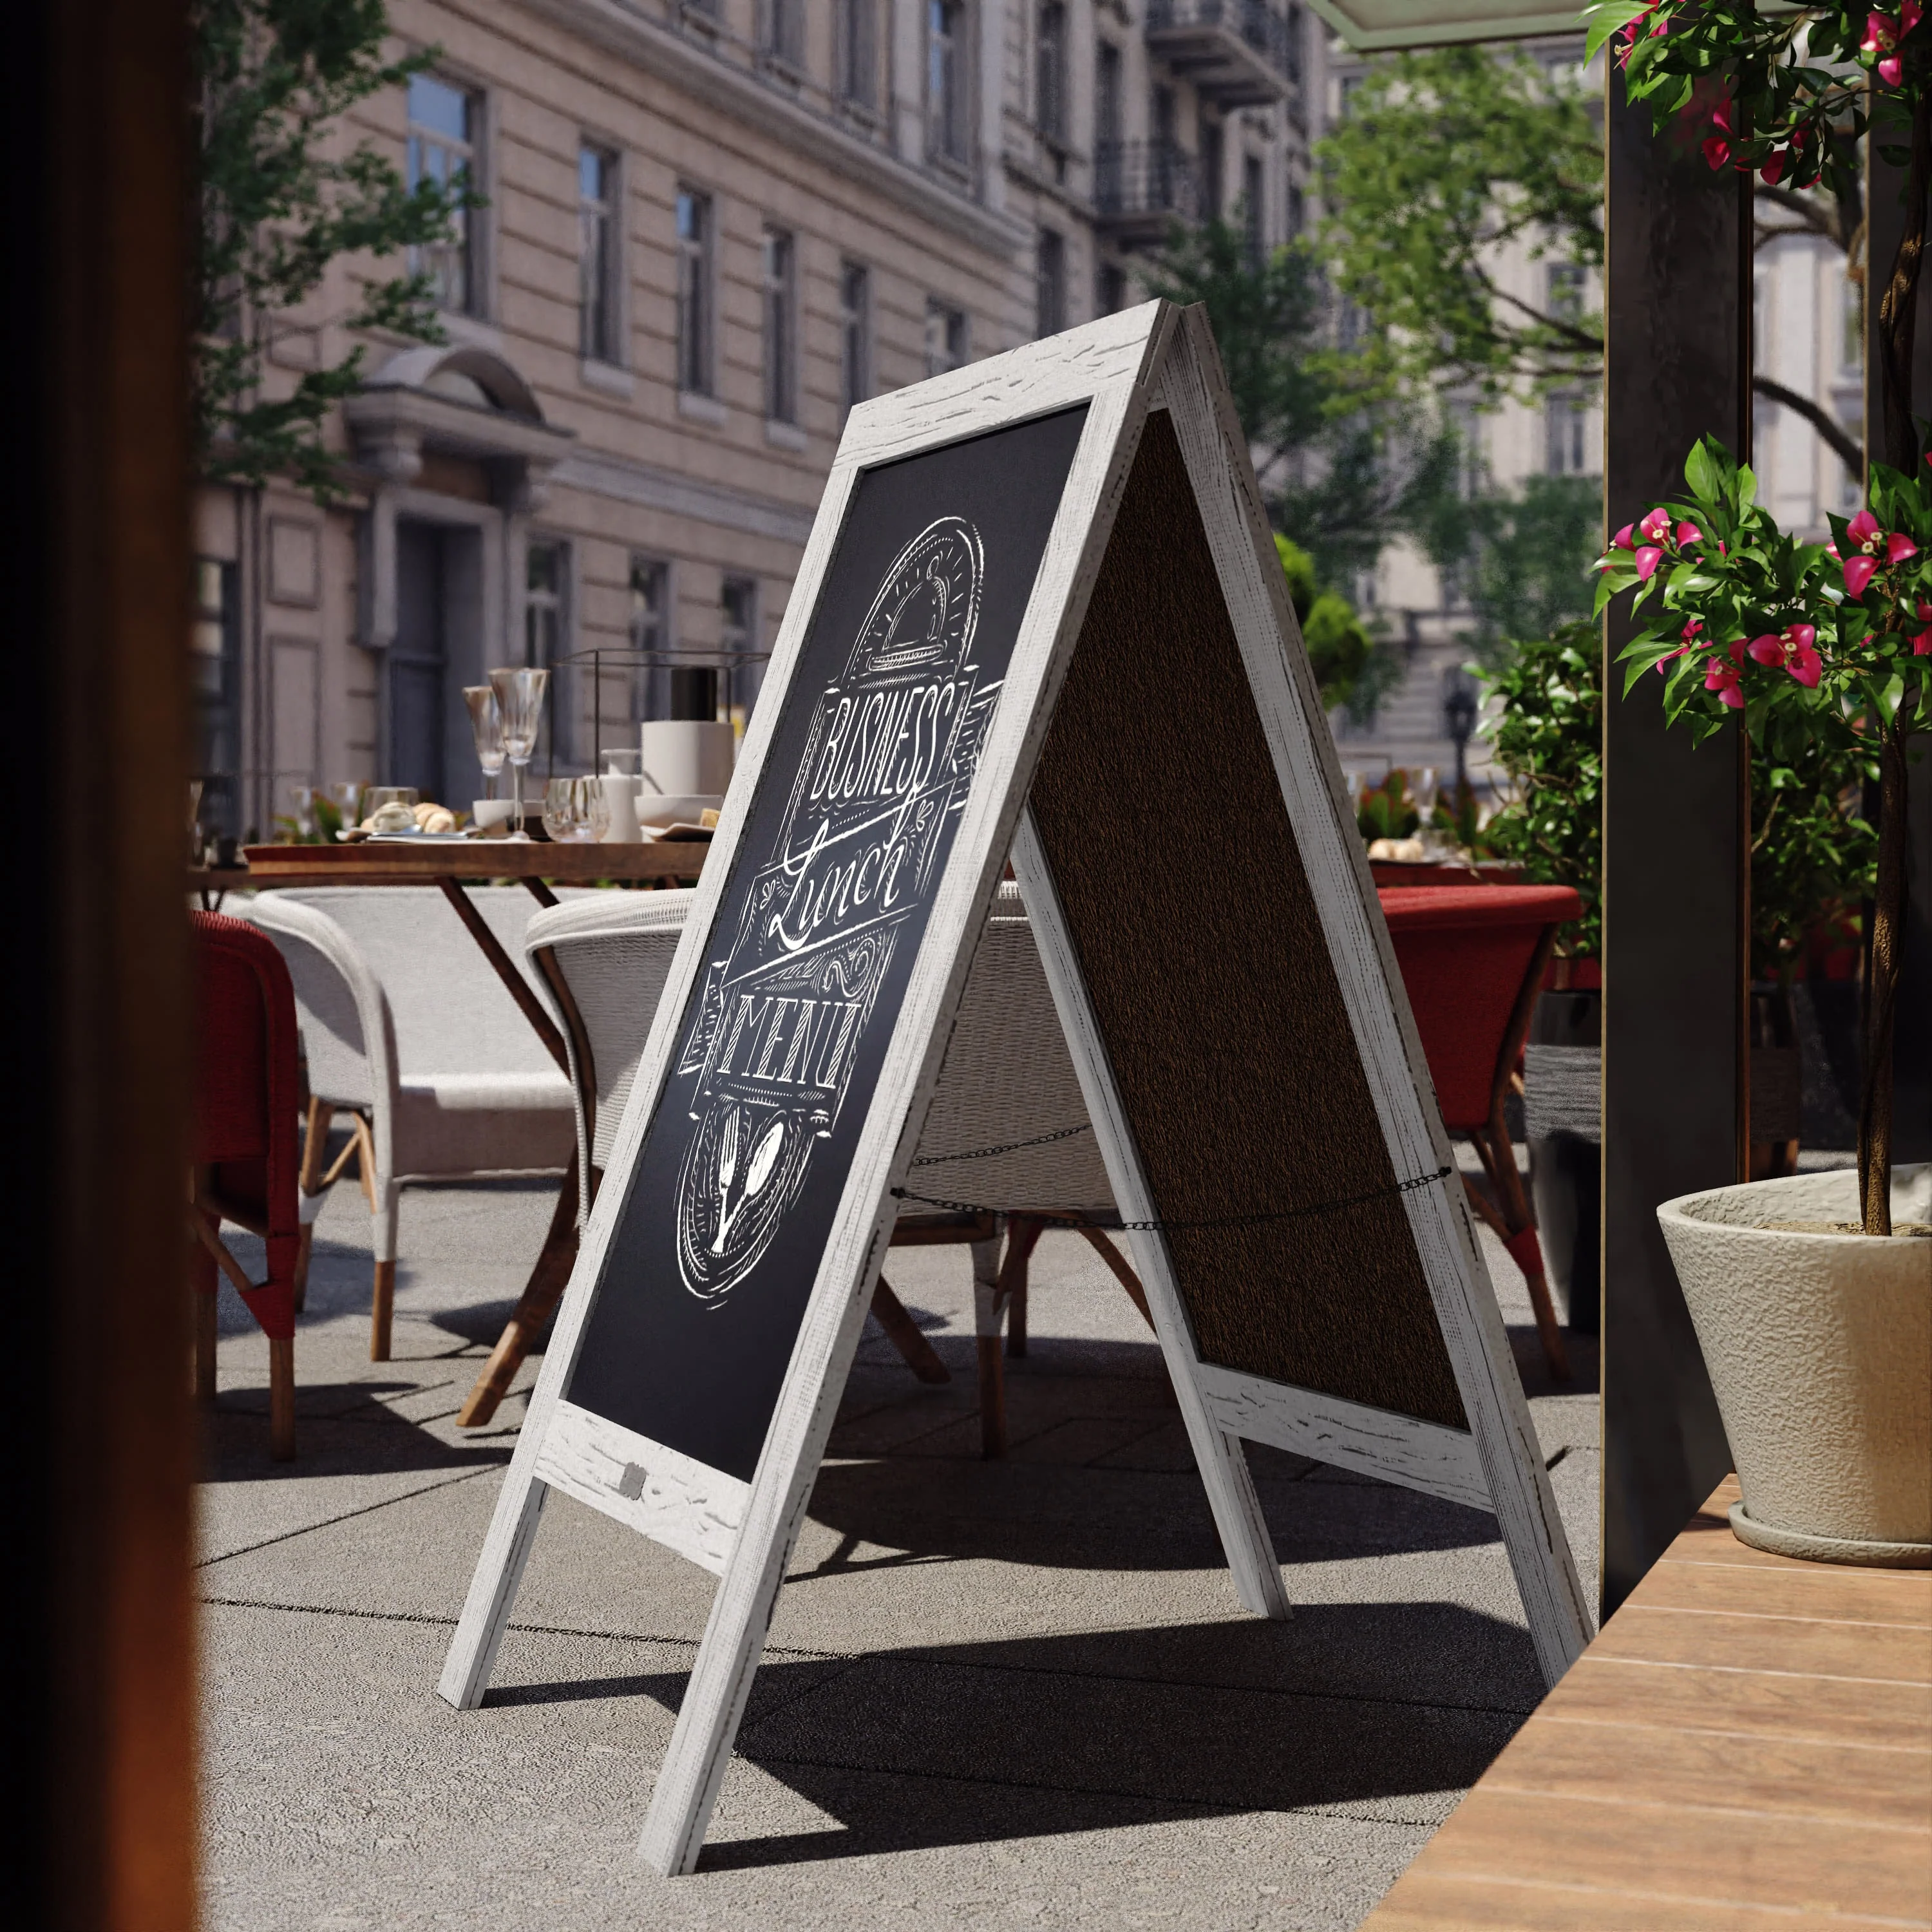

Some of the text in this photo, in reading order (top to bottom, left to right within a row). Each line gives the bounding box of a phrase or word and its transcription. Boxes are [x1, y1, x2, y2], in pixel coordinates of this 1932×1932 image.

[810, 682, 955, 800] BUSINESS
[768, 786, 916, 950] Lunch
[717, 994, 862, 1088] MENU
